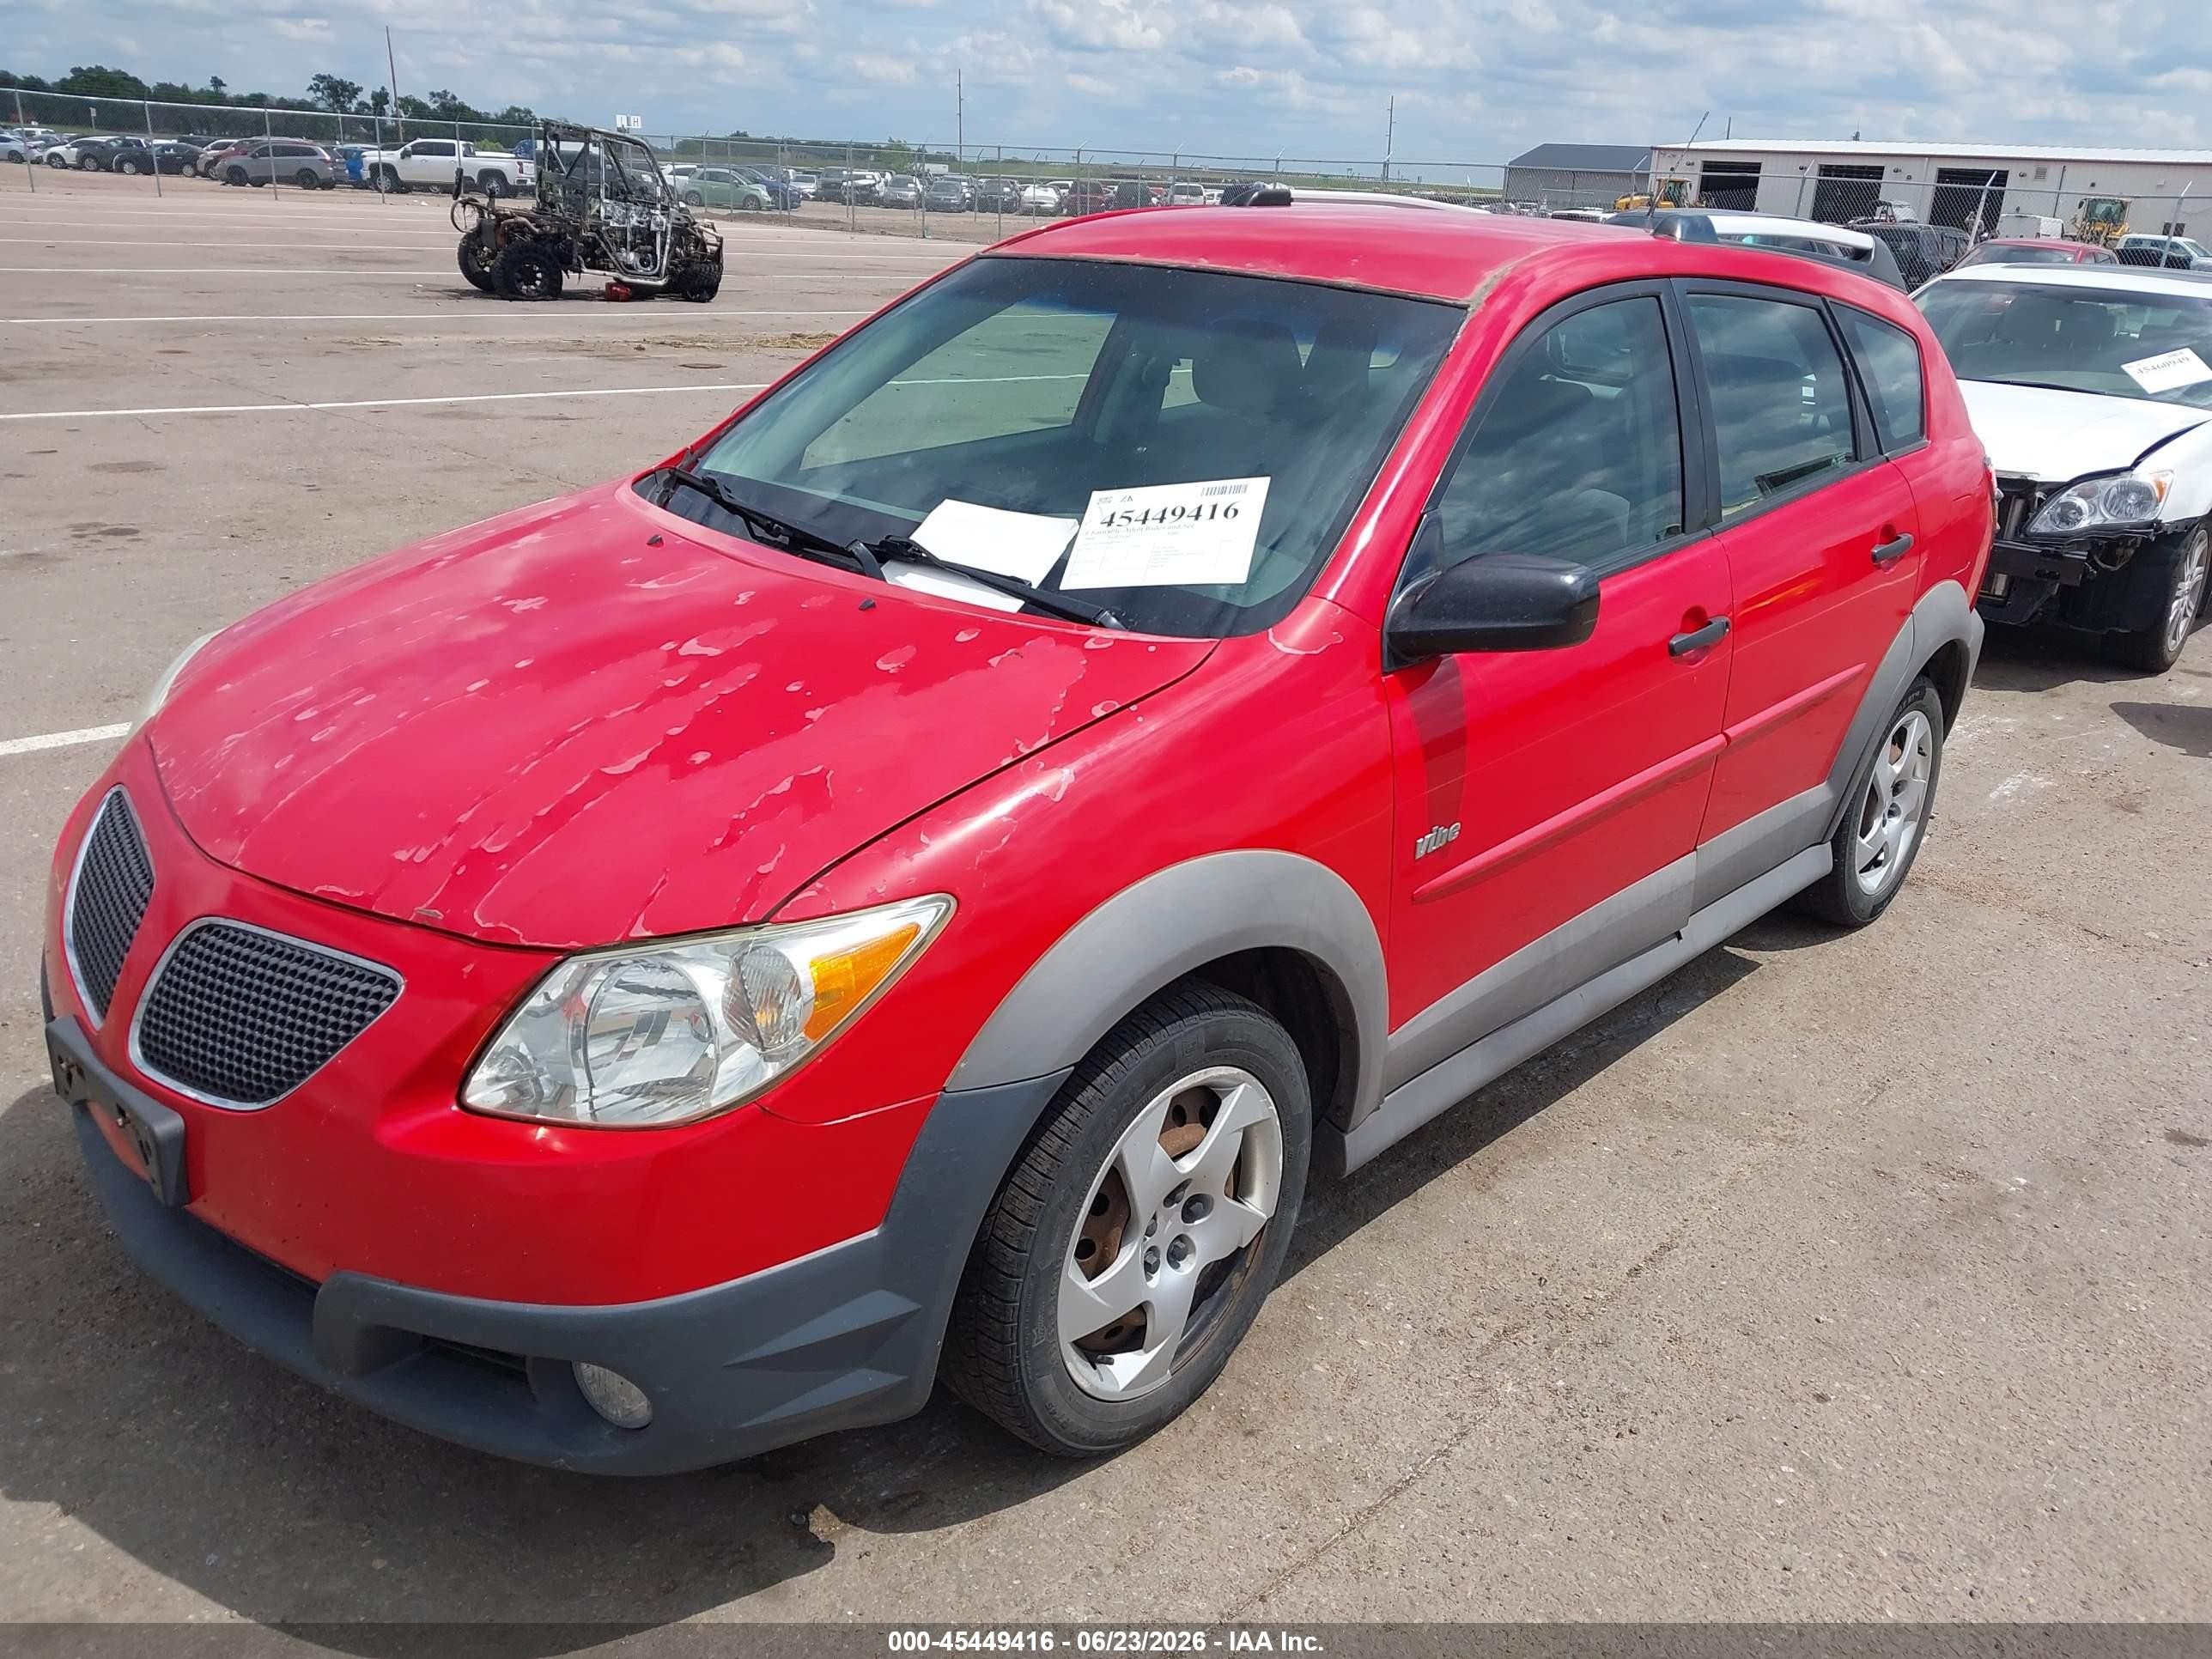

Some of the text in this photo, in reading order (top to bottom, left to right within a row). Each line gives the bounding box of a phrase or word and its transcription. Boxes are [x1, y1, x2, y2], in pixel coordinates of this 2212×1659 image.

[633, 117, 639, 126] H
[1100, 501, 1240, 527] 45449416
[1415, 822, 1462, 860] Vibe
